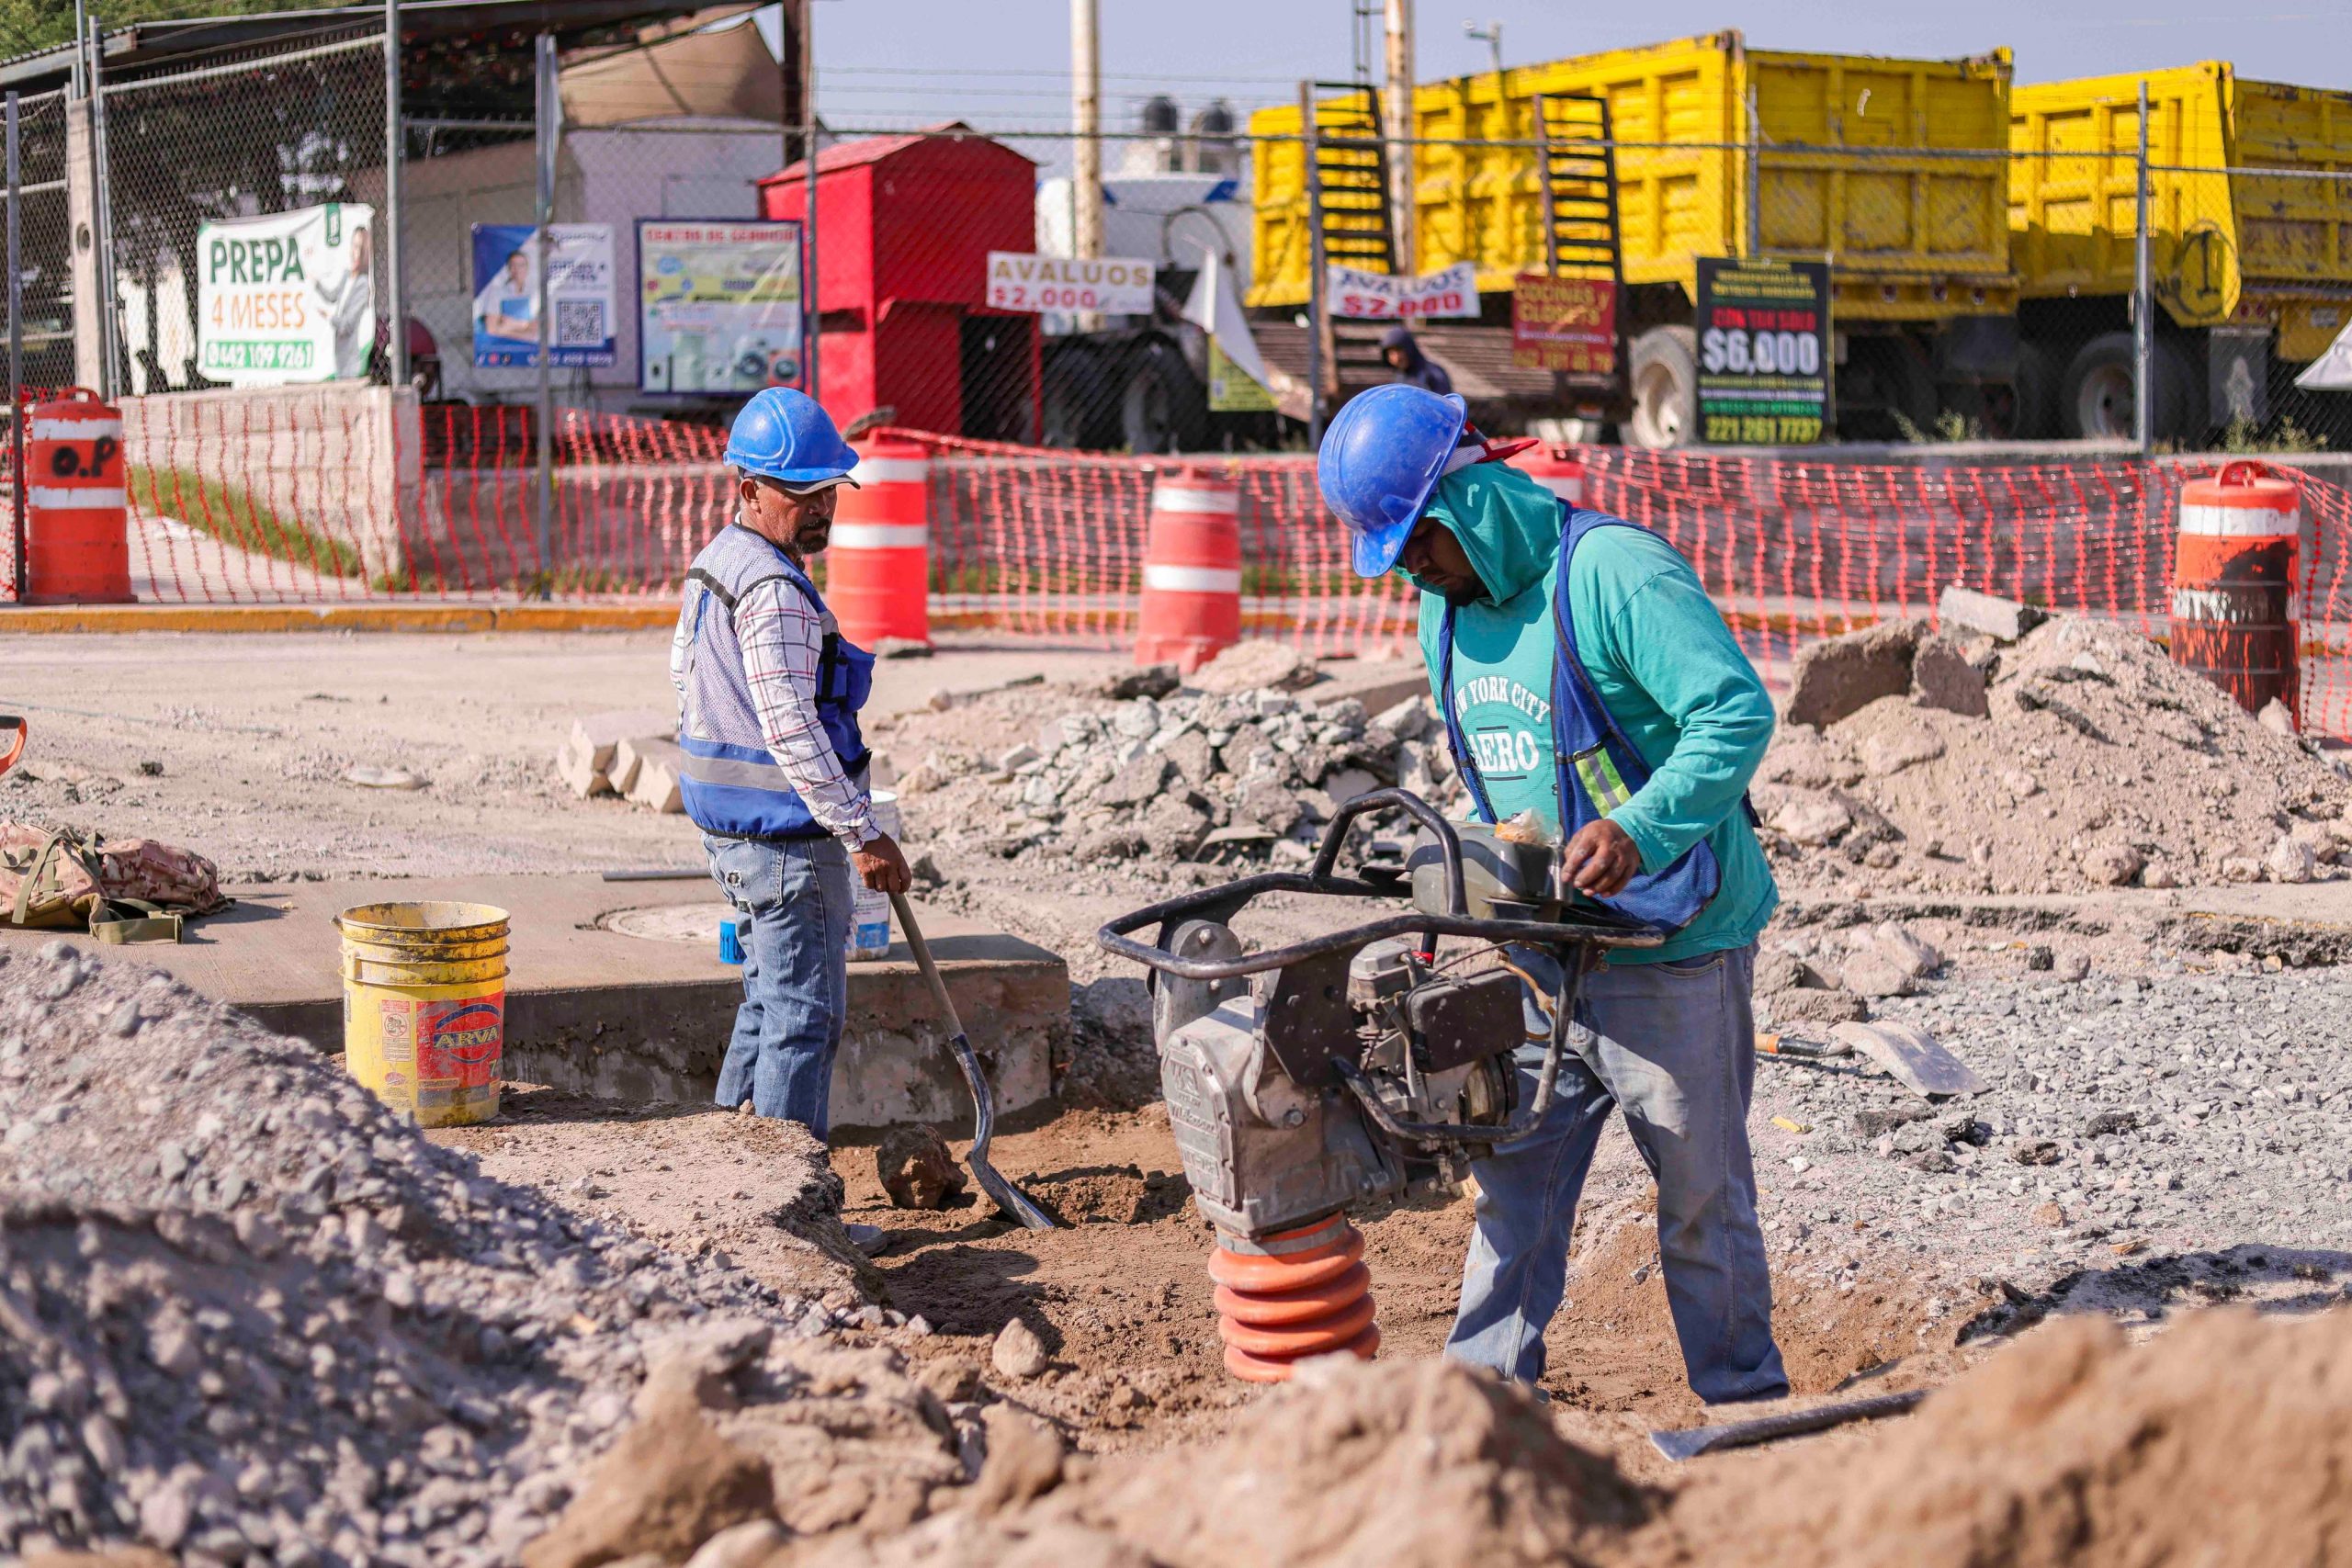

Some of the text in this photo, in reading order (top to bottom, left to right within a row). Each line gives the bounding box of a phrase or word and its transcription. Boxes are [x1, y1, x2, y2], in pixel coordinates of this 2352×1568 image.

[209, 236, 305, 285] PREPA
[995, 260, 1148, 288] AVALUOS
[1340, 270, 1465, 297] AVALUOS
[212, 291, 307, 330] 4 MESES
[1702, 326, 1819, 376] $6,000
[1454, 676, 1551, 724] EW YORK CITY
[1467, 730, 1540, 773] AERO
